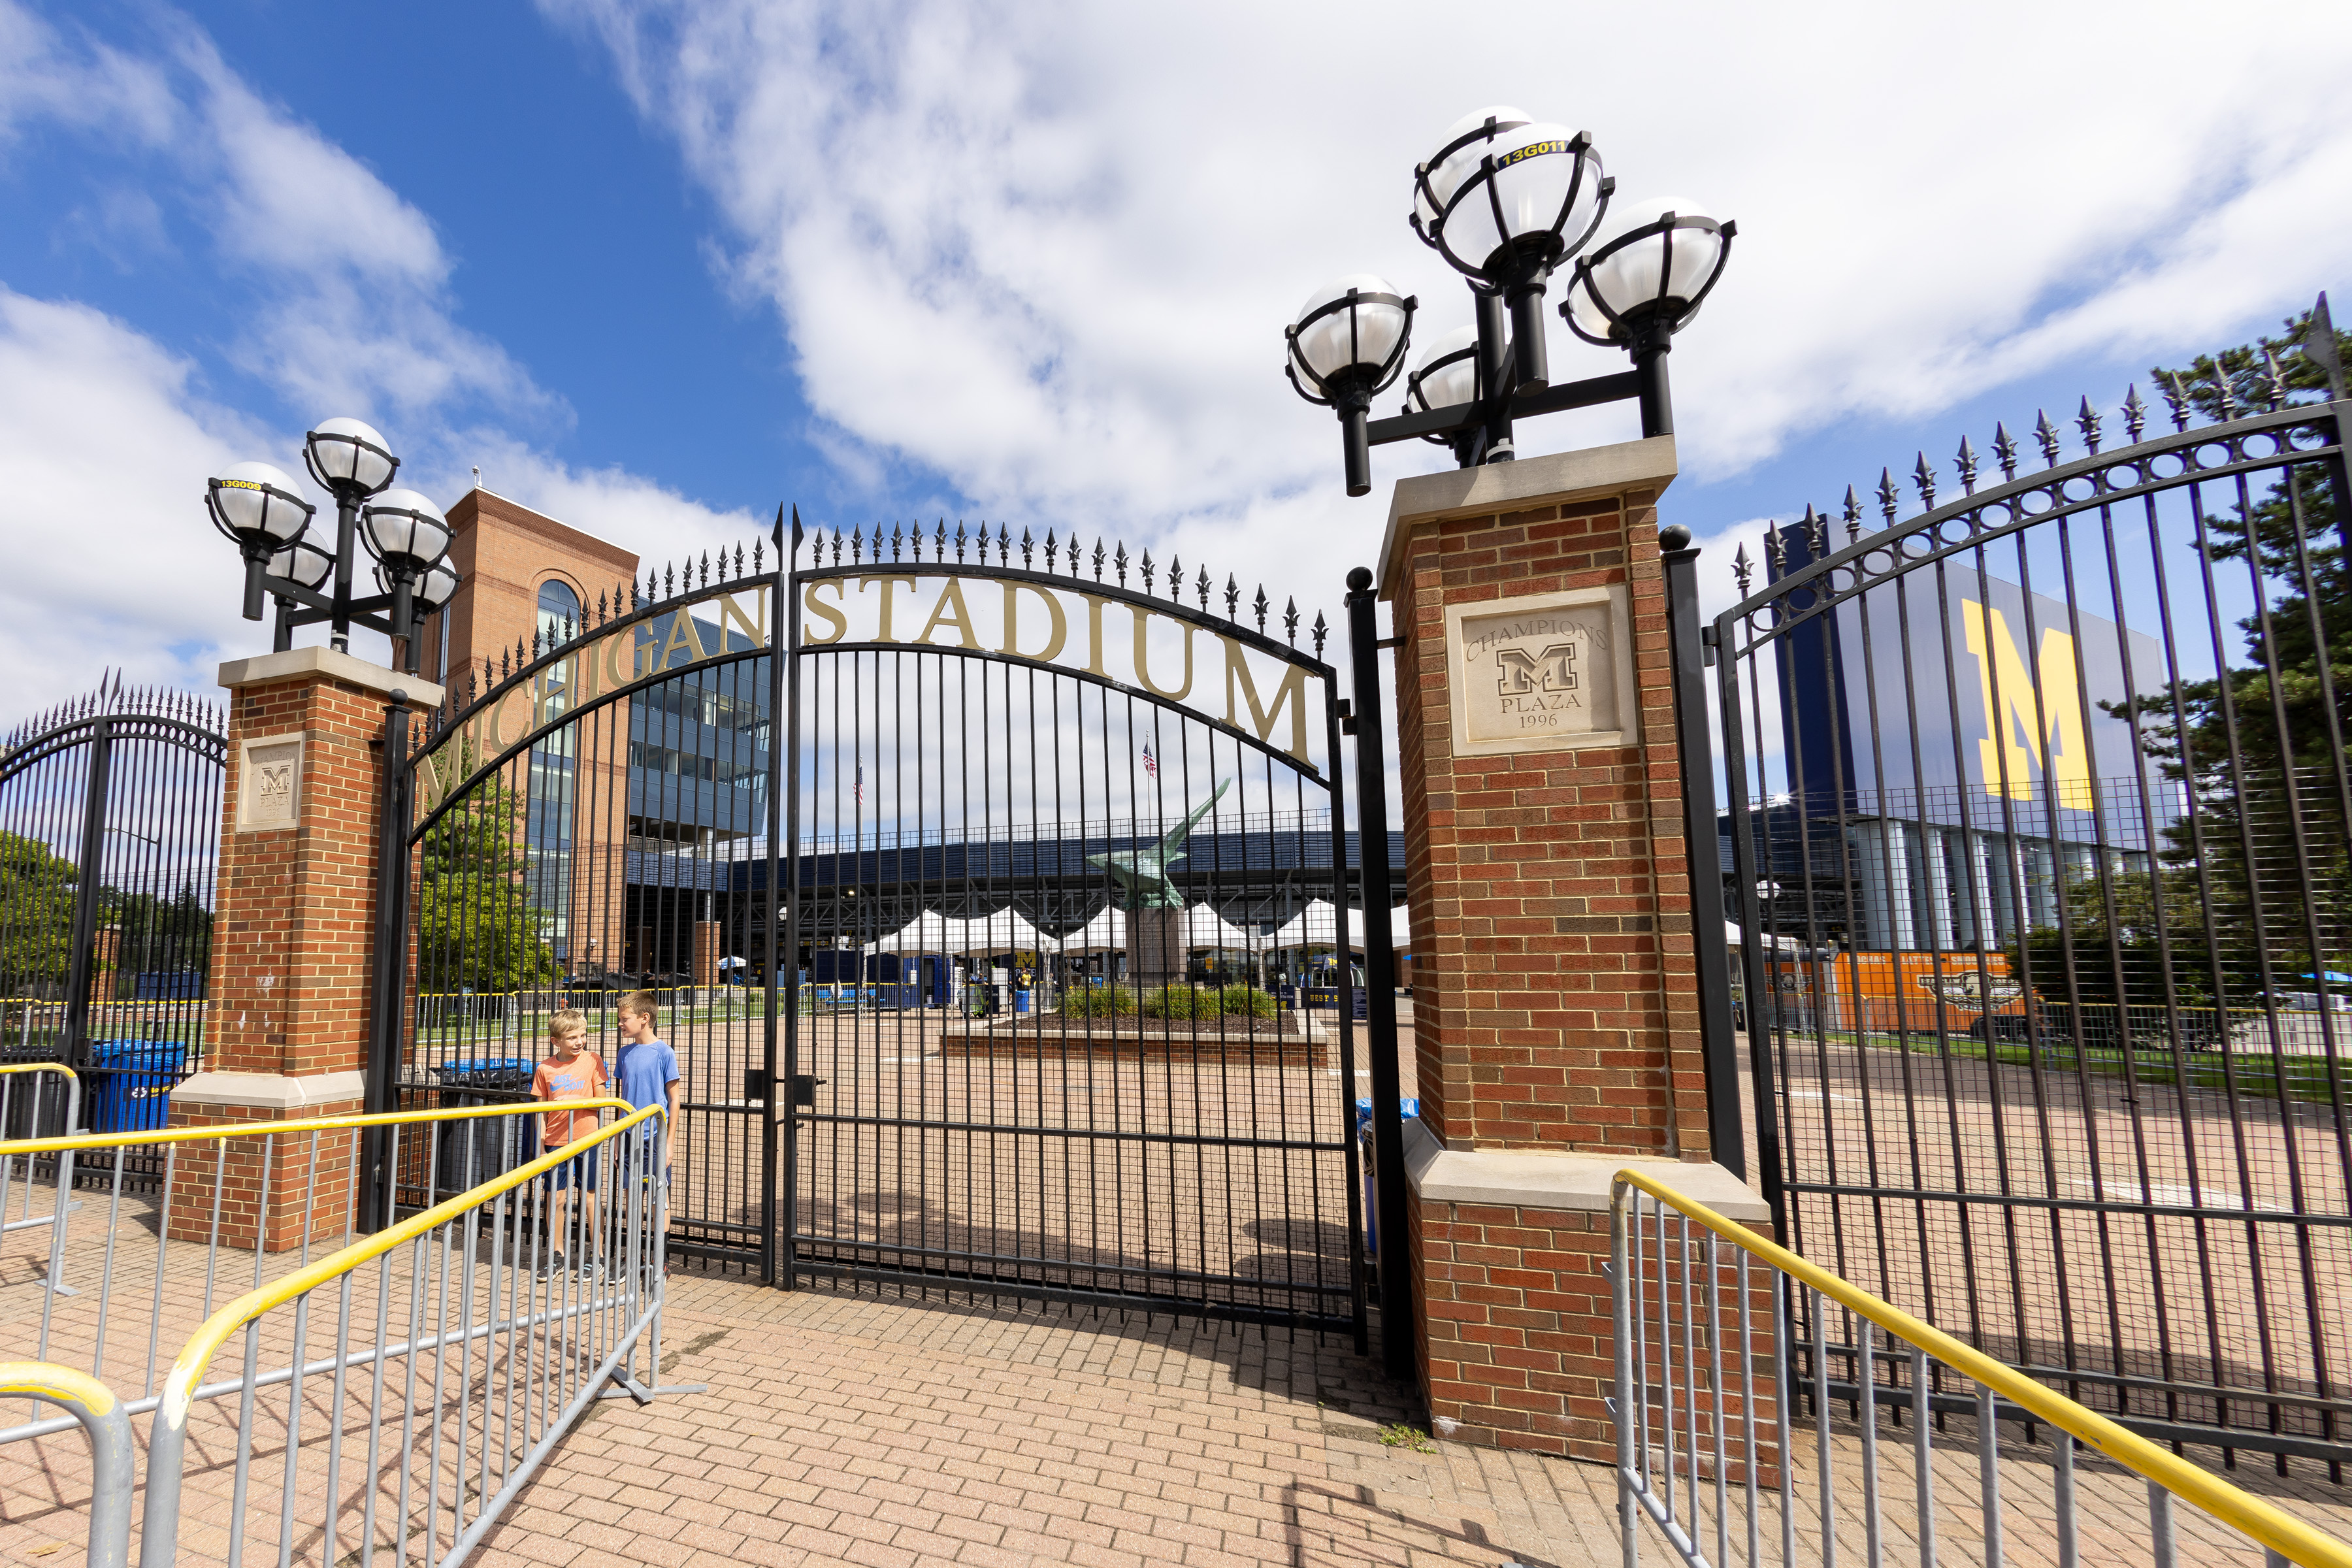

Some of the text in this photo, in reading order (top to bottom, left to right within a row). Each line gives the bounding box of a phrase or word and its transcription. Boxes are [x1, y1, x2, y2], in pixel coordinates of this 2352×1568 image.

[1503, 141, 1565, 166] 13G011
[221, 480, 261, 491] 13G009
[1466, 619, 1607, 662] CHAMPIONS
[1496, 642, 1578, 696] M
[414, 574, 1320, 830] MICHIGAN STADIUM
[1500, 693, 1582, 713] PLAZA
[1520, 713, 1558, 728] 1996
[261, 765, 291, 796] M
[259, 796, 289, 807] PLAZA
[1951, 956, 2004, 966] SMOOHIES
[553, 1074, 572, 1085] JUST
